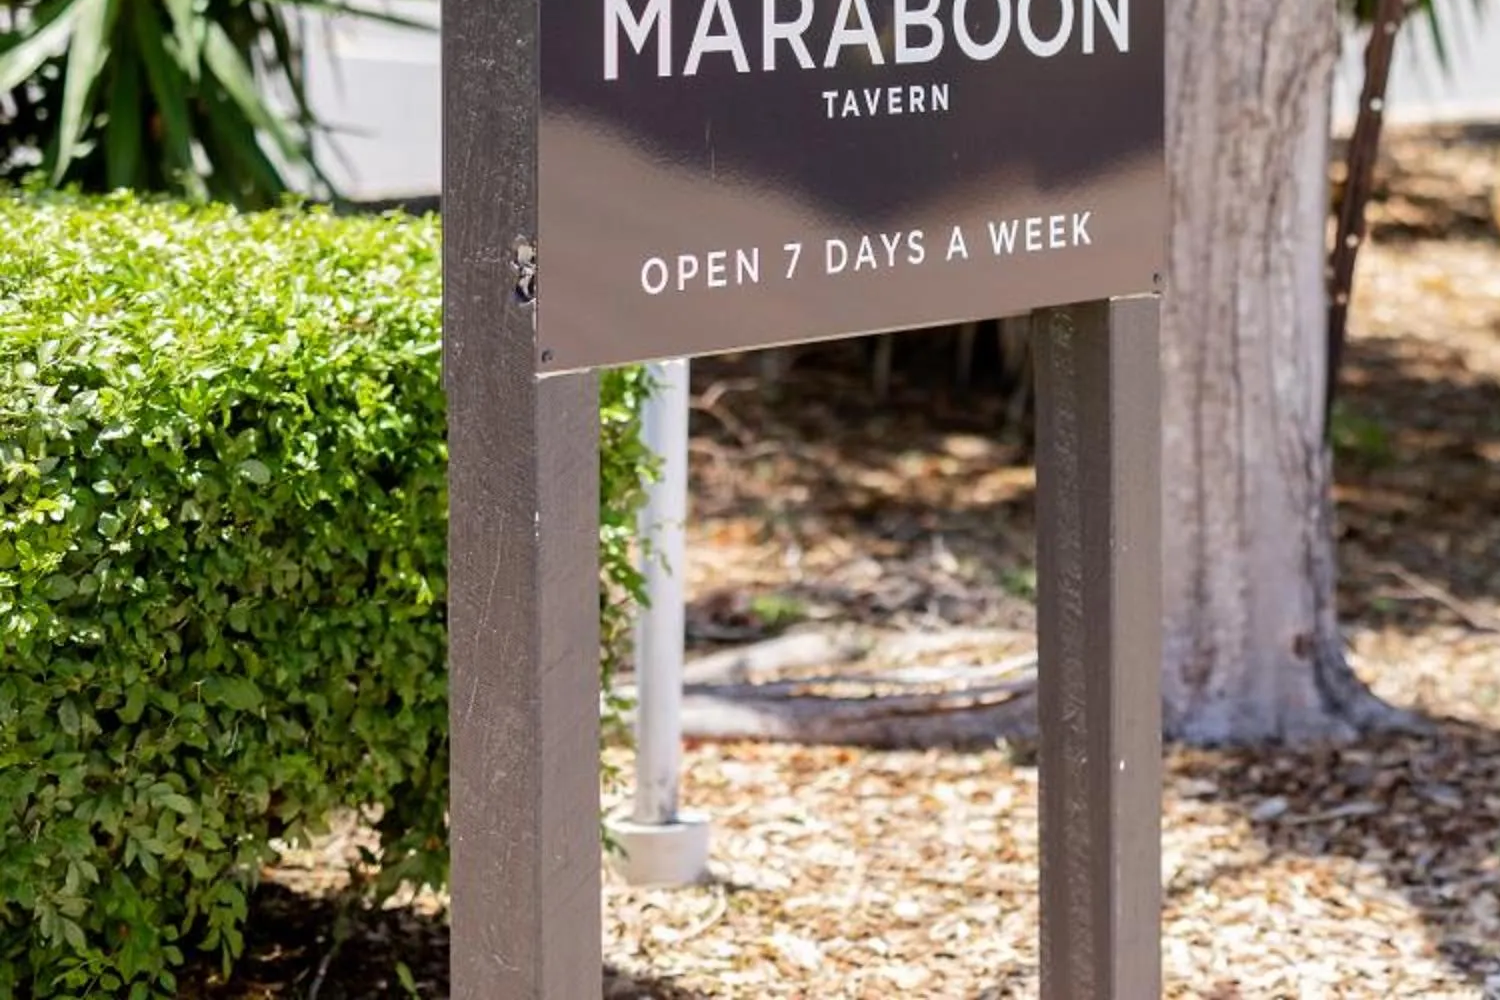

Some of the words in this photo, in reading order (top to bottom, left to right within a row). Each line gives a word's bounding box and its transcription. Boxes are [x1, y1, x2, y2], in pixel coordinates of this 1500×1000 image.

[822, 83, 950, 119] TAVERN
[641, 247, 760, 295] OPEN
[783, 242, 802, 279] 7
[826, 229, 926, 274] DAYS
[946, 225, 969, 261] A
[988, 211, 1094, 256] WEEK
